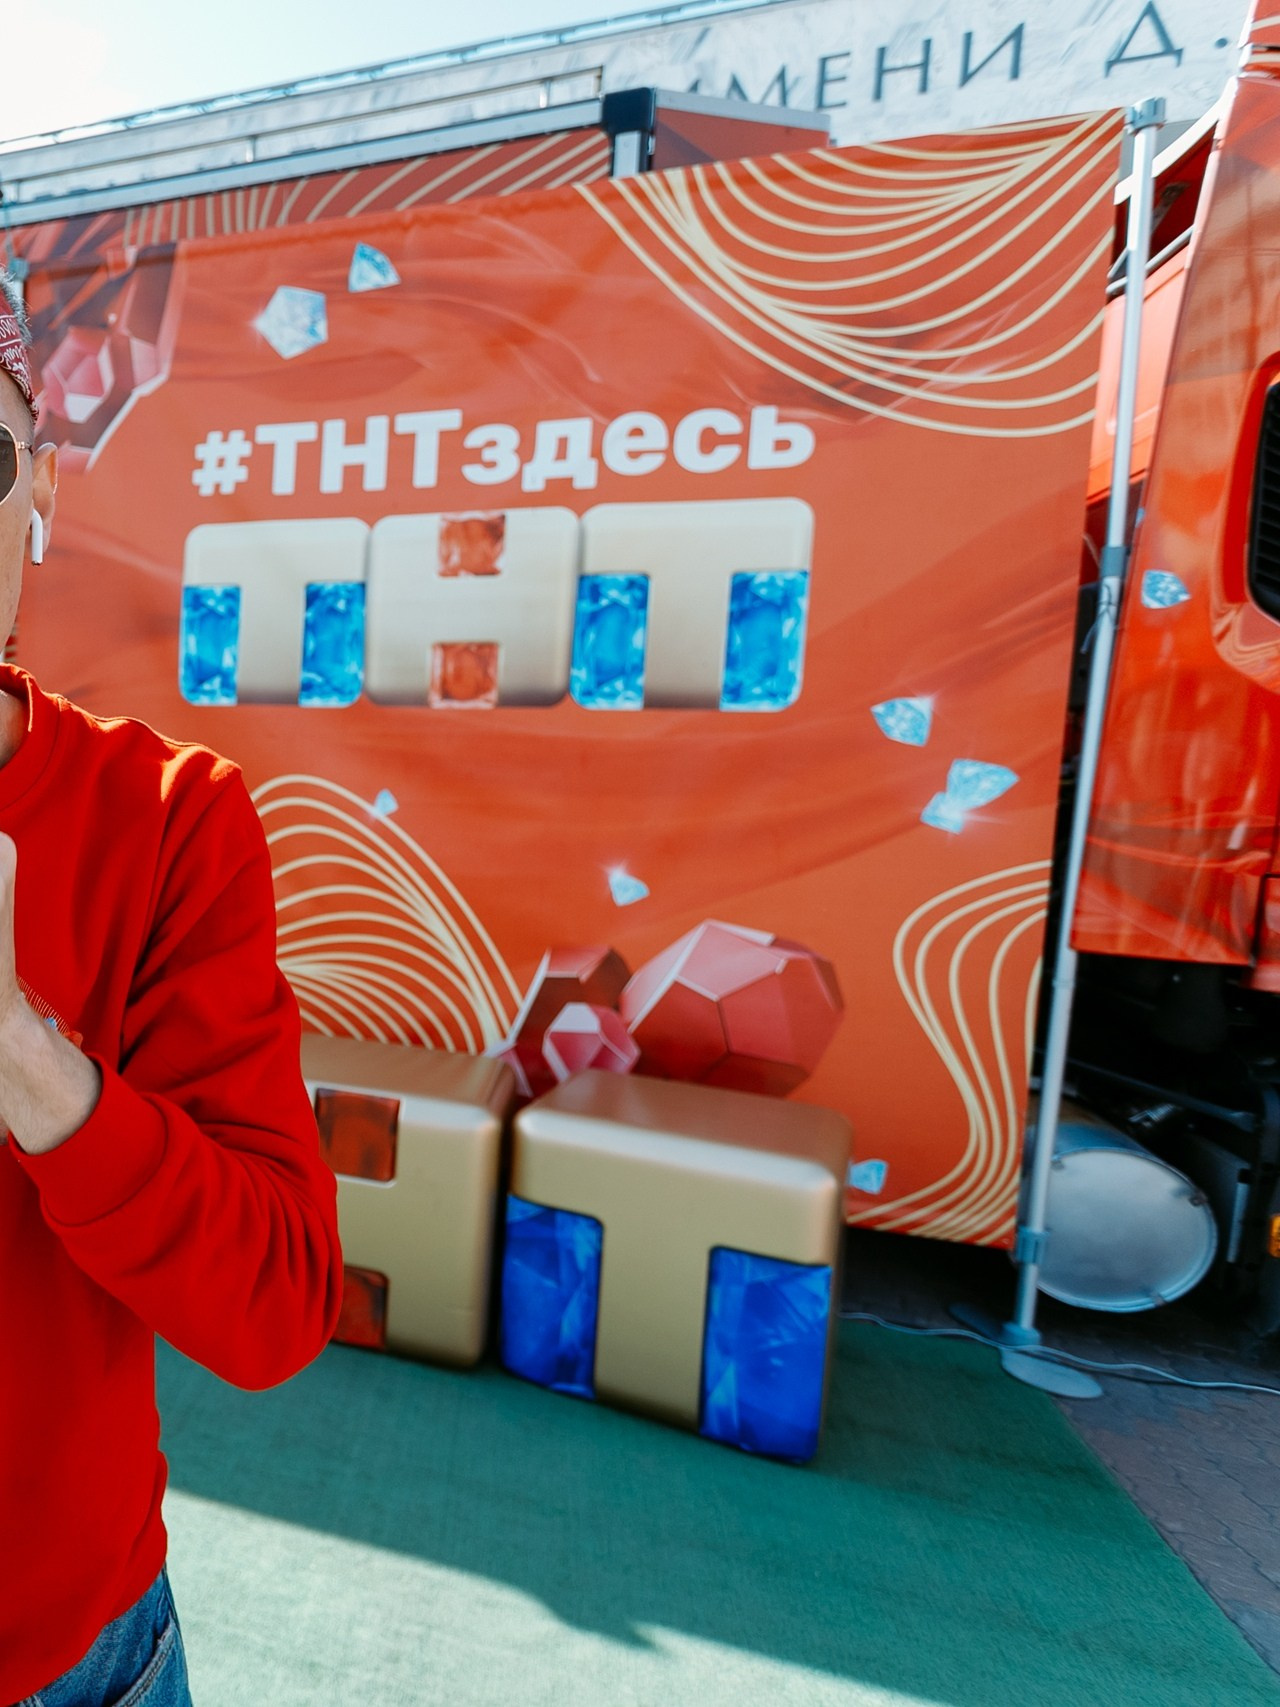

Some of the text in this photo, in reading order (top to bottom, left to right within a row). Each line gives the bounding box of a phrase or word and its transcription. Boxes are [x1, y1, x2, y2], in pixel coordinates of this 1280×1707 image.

[687, 22, 1025, 111] МЕНИ
[191, 405, 816, 496] #ТНТздесь
[179, 497, 815, 712] ТНТ
